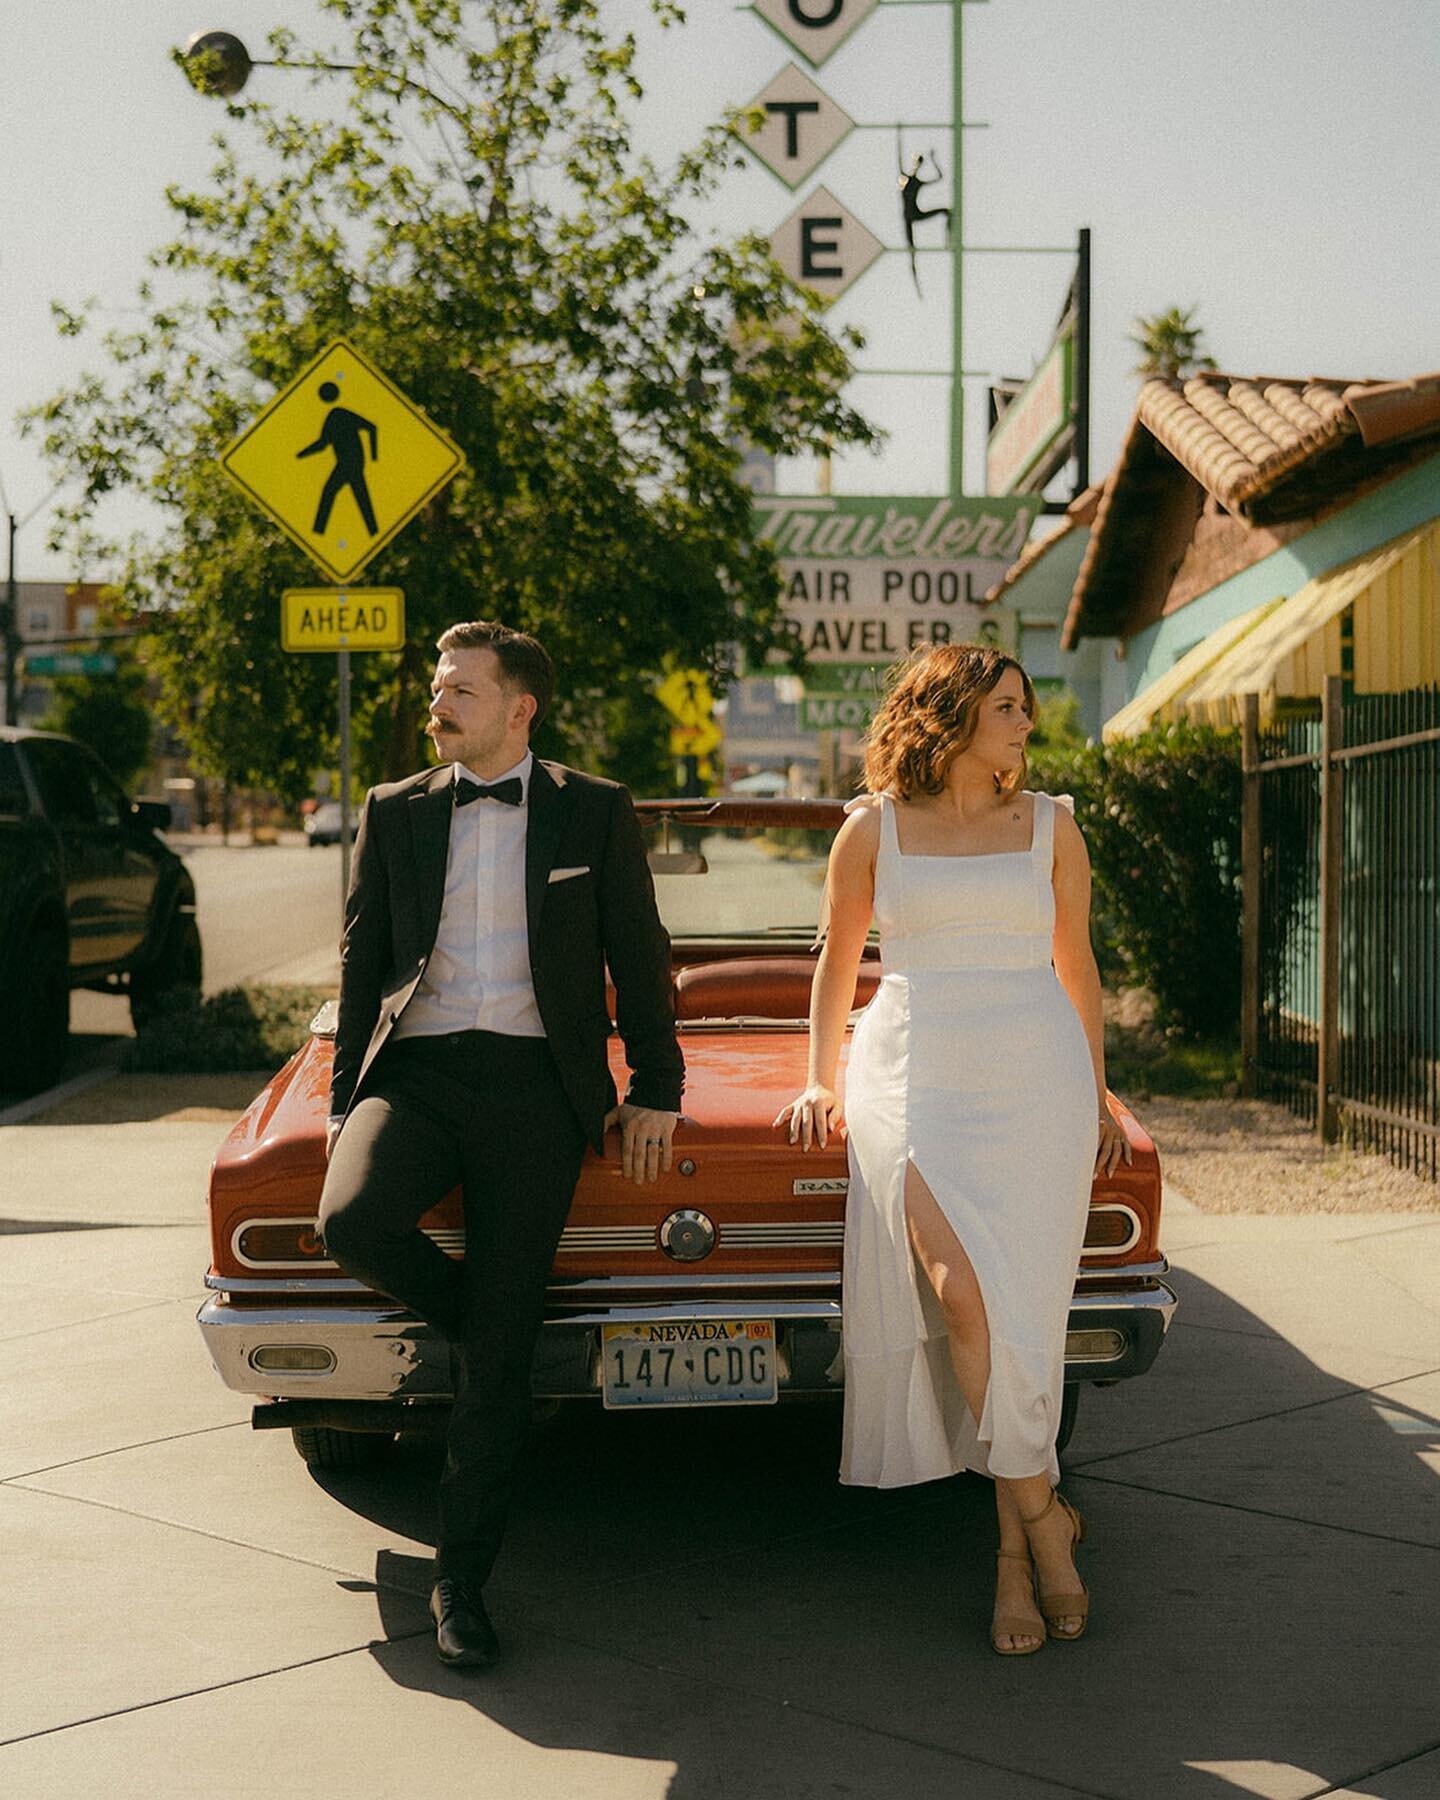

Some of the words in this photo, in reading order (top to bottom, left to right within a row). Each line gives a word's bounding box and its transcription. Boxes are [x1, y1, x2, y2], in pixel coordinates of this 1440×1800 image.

[751, 498, 1034, 557] Travelers
[787, 569, 851, 603] AIR
[883, 570, 985, 605] POOL
[301, 606, 388, 634] AHEAD
[648, 1323, 730, 1343] NEVADA
[613, 1348, 676, 1389] 147
[703, 1345, 767, 1386] CDG
